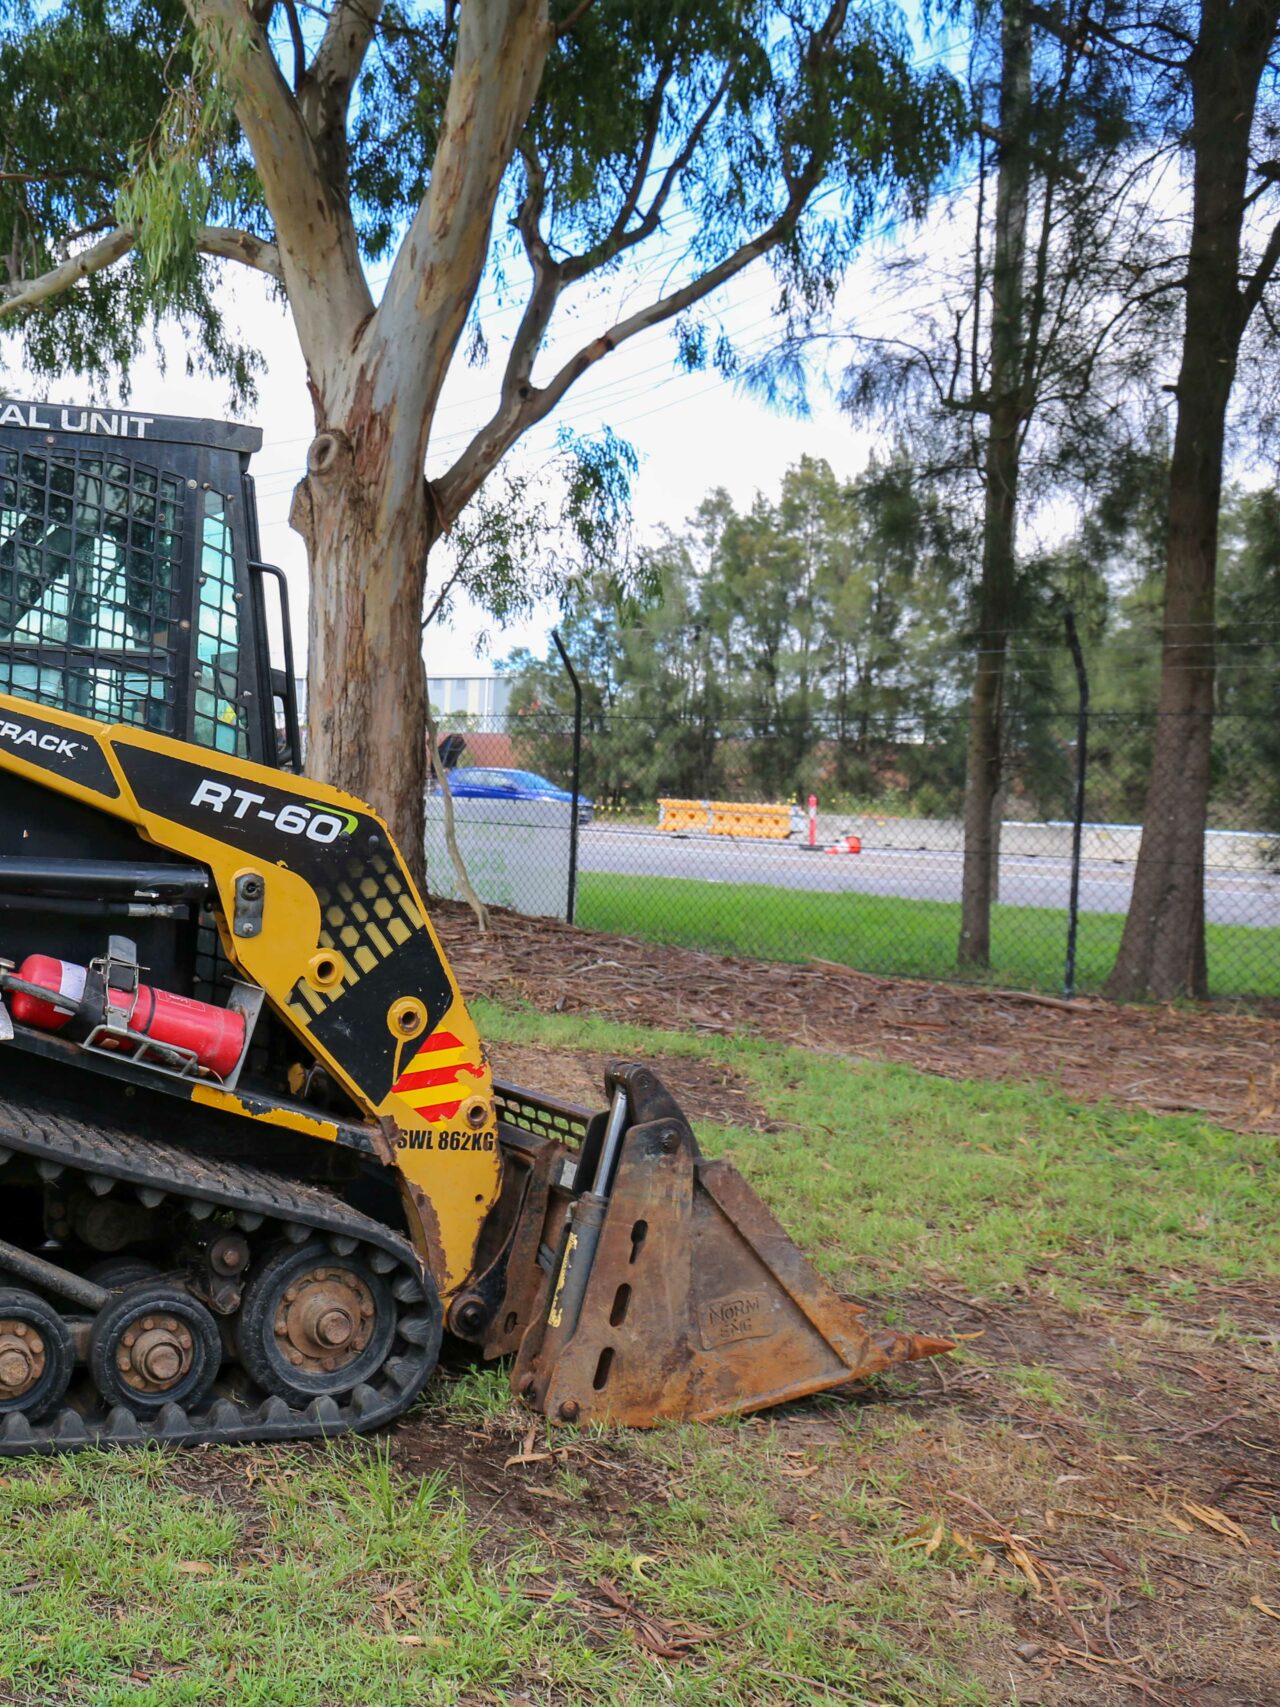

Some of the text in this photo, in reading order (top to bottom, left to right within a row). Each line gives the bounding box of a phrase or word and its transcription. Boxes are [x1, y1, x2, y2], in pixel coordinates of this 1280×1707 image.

[61, 409, 154, 439] UNIT
[190, 779, 343, 844] RT-60
[397, 1129, 495, 1152] SWL 862KG
